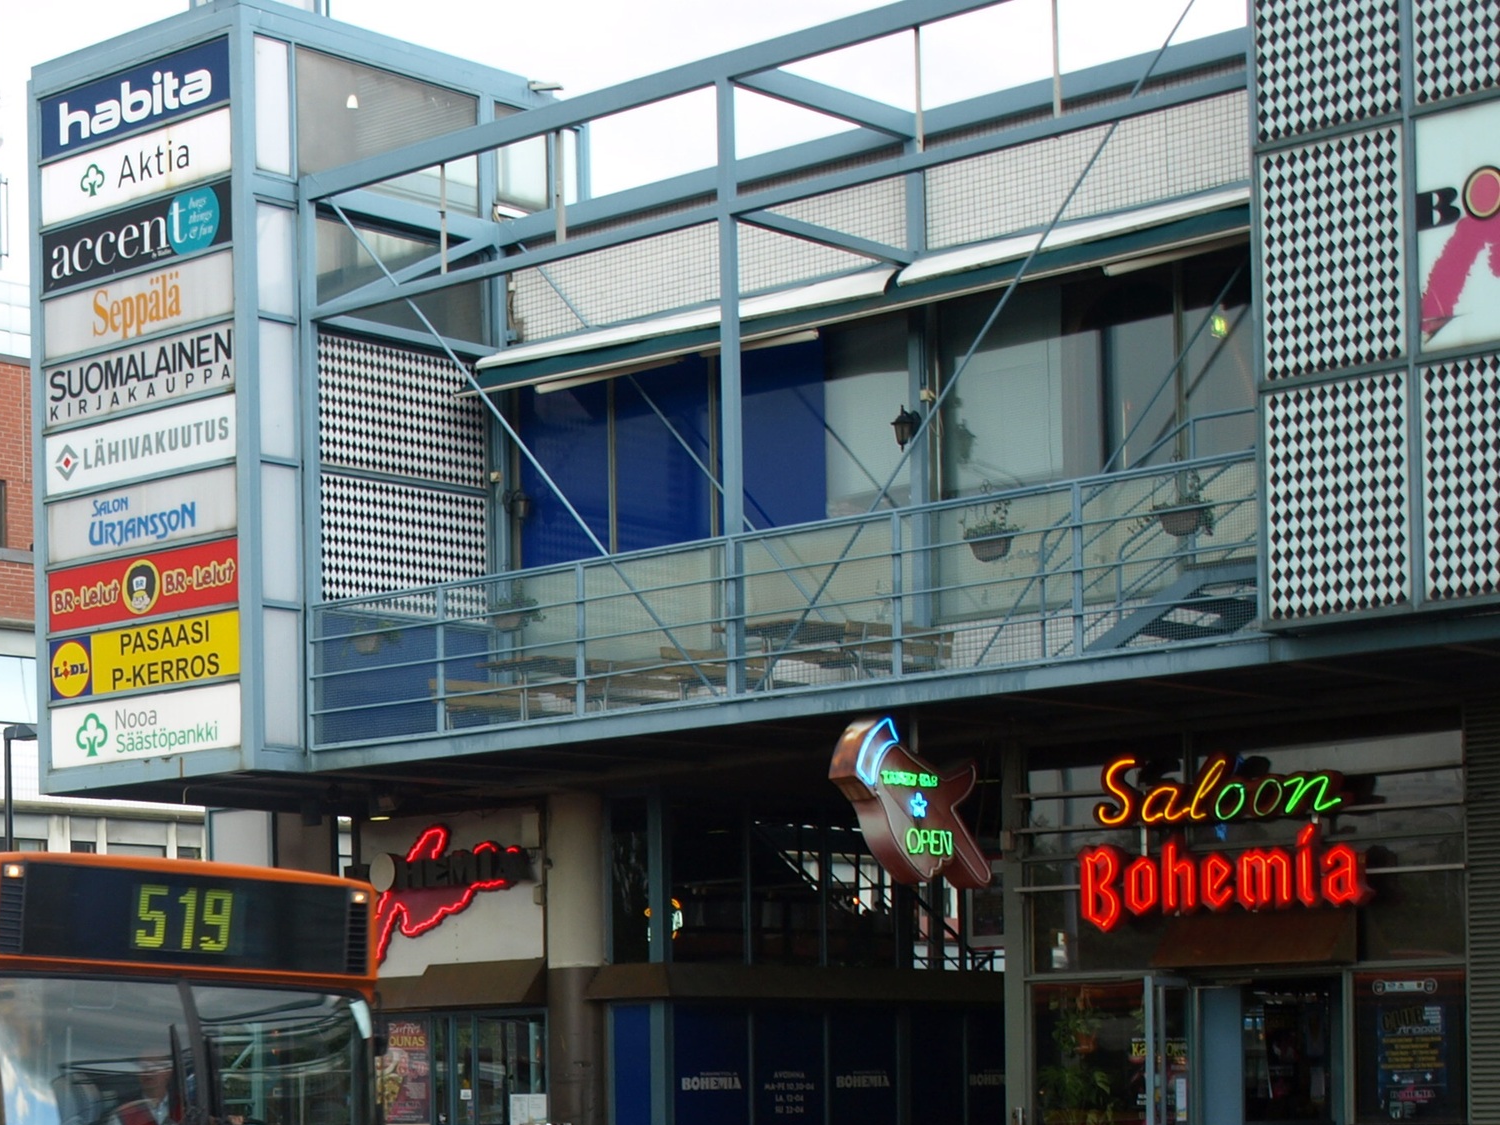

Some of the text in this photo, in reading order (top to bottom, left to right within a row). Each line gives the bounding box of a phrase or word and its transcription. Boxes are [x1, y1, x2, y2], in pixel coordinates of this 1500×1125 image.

[58, 69, 212, 146] habita
[117, 140, 190, 189] Aktia
[51, 201, 190, 281] accent
[92, 271, 182, 340] Seppälä
[50, 329, 232, 402] SUOMALAINEN
[50, 364, 231, 422] KIRJAKAUPPA
[83, 416, 229, 470] LÄHIVAKUUTUS
[88, 501, 196, 547] URJANSSON
[92, 496, 129, 518] SALON
[120, 619, 210, 656] PASAASI
[112, 652, 220, 691] P-KERROS
[115, 706, 158, 731] Nooa
[115, 719, 219, 755] Säästöpankki
[1097, 759, 1342, 825] Saloon
[906, 827, 953, 856] OPEN
[135, 884, 233, 951] 519
[388, 1035, 426, 1047] OUNAS
[681, 1076, 742, 1091] BOHEMIA
[835, 1075, 890, 1088] BOHEMIA
